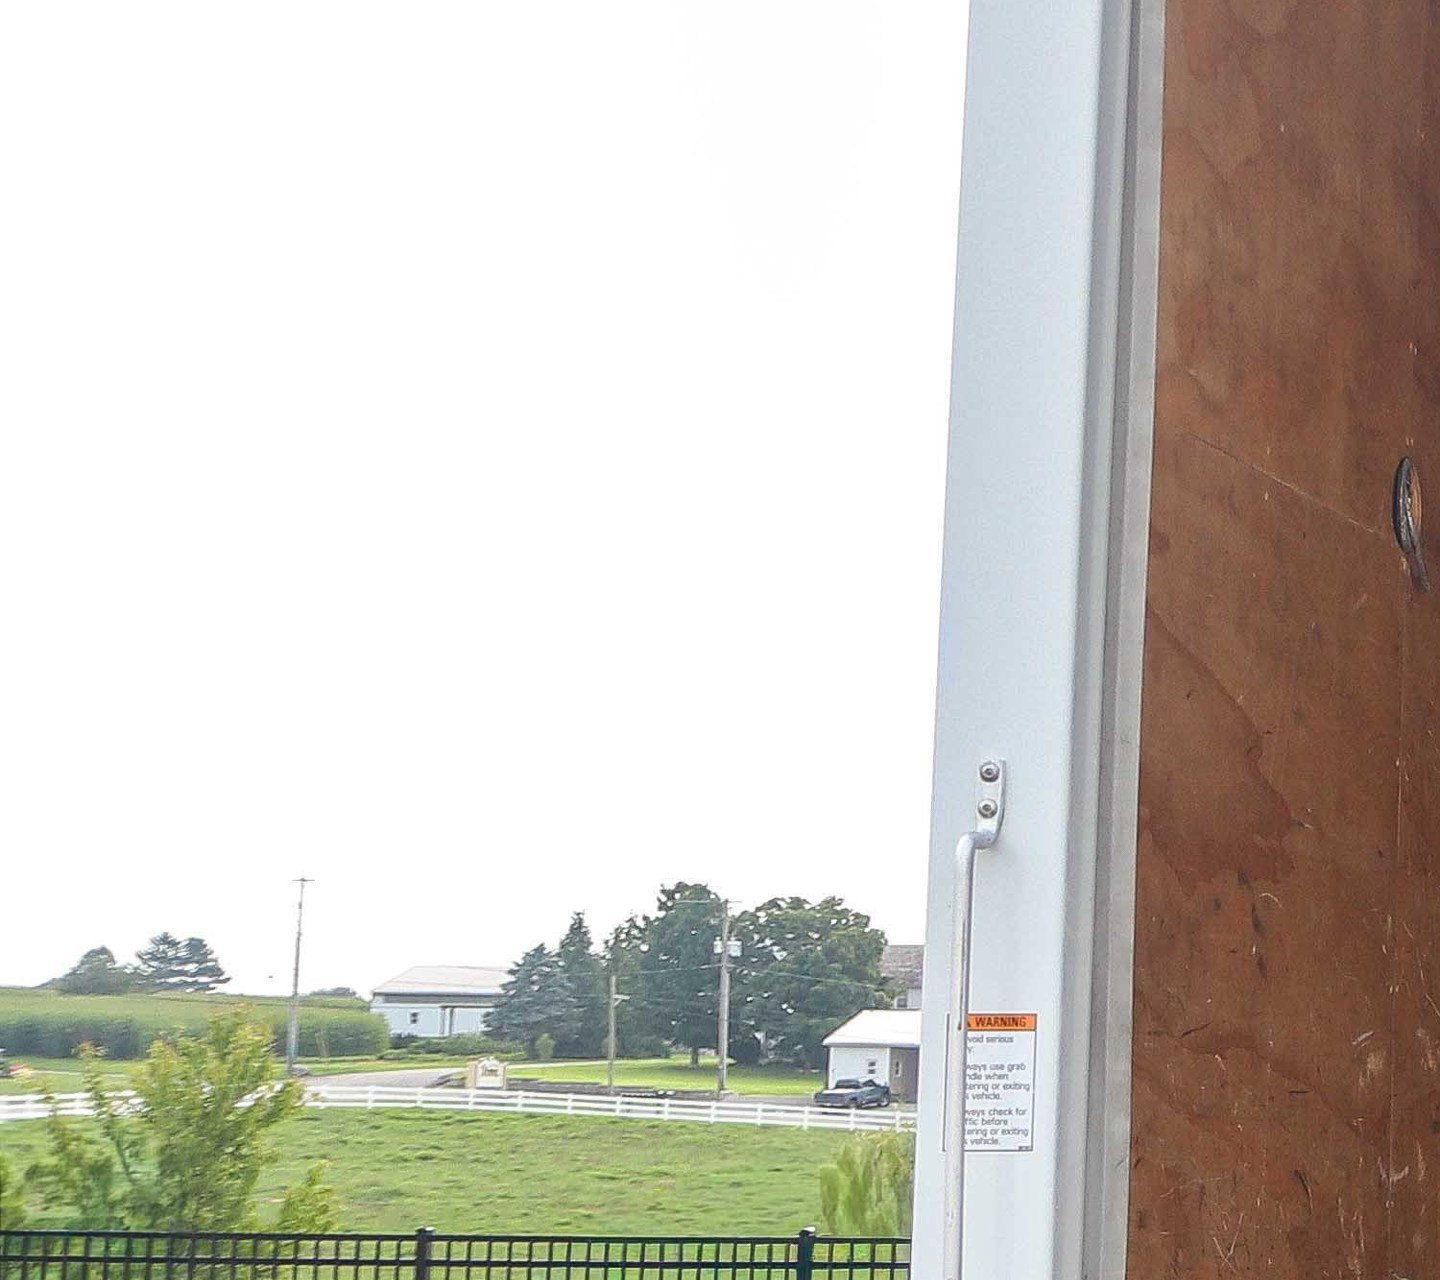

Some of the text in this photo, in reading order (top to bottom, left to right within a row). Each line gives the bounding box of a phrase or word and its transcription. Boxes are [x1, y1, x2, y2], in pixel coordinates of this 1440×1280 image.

[975, 1016, 1027, 1027] WARNING
[967, 1034, 1015, 1044] void serious
[1007, 1062, 1027, 1073] grab
[987, 1108, 1014, 1116] check
[981, 1117, 1009, 1126] before
